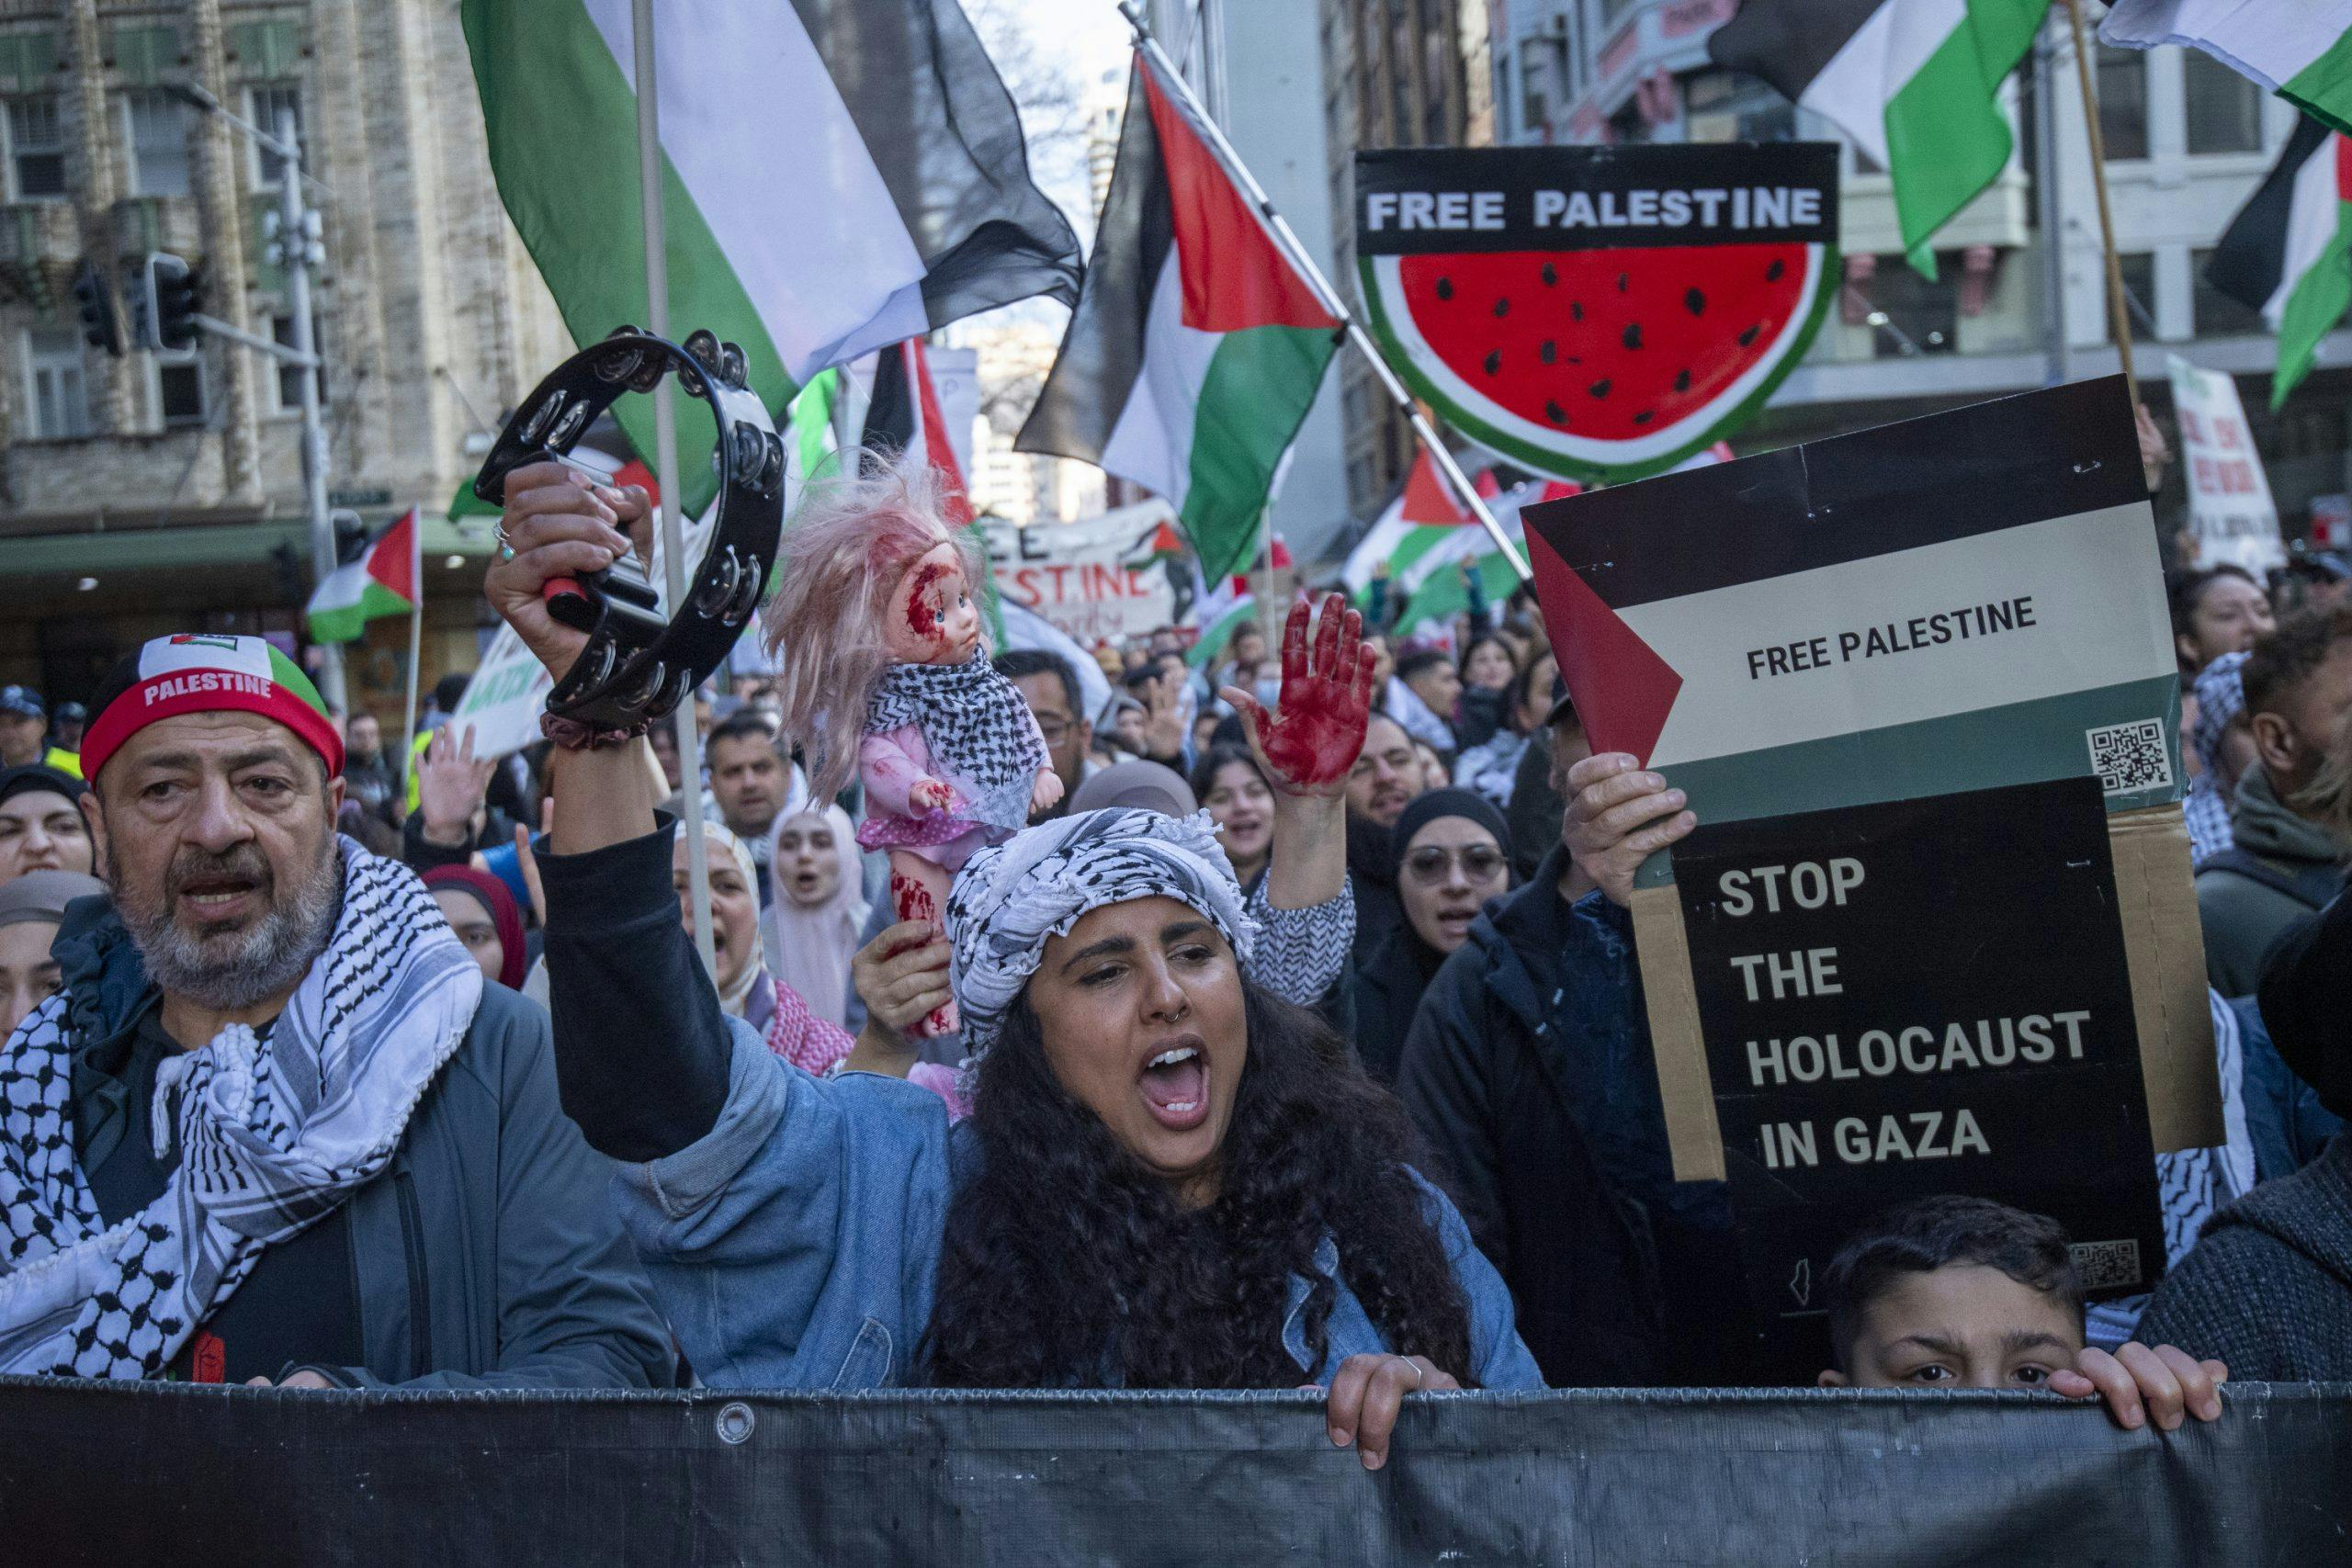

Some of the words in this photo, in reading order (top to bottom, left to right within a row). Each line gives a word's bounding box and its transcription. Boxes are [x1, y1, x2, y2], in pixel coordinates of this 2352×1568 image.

[1366, 190, 1506, 231] FREE
[1532, 187, 1822, 230] PALESTINE
[992, 562, 1148, 607] STINE
[1747, 637, 1831, 680] FREE
[1838, 595, 2037, 662] PALESTINE
[143, 672, 272, 706] PALESTINE
[1719, 857, 1866, 917] STOP
[1730, 946, 1843, 1002] THE
[1746, 1010, 2091, 1086] HOLOCAUST
[1760, 1120, 1819, 1169] IN
[1834, 1108, 1992, 1165] GAZA
